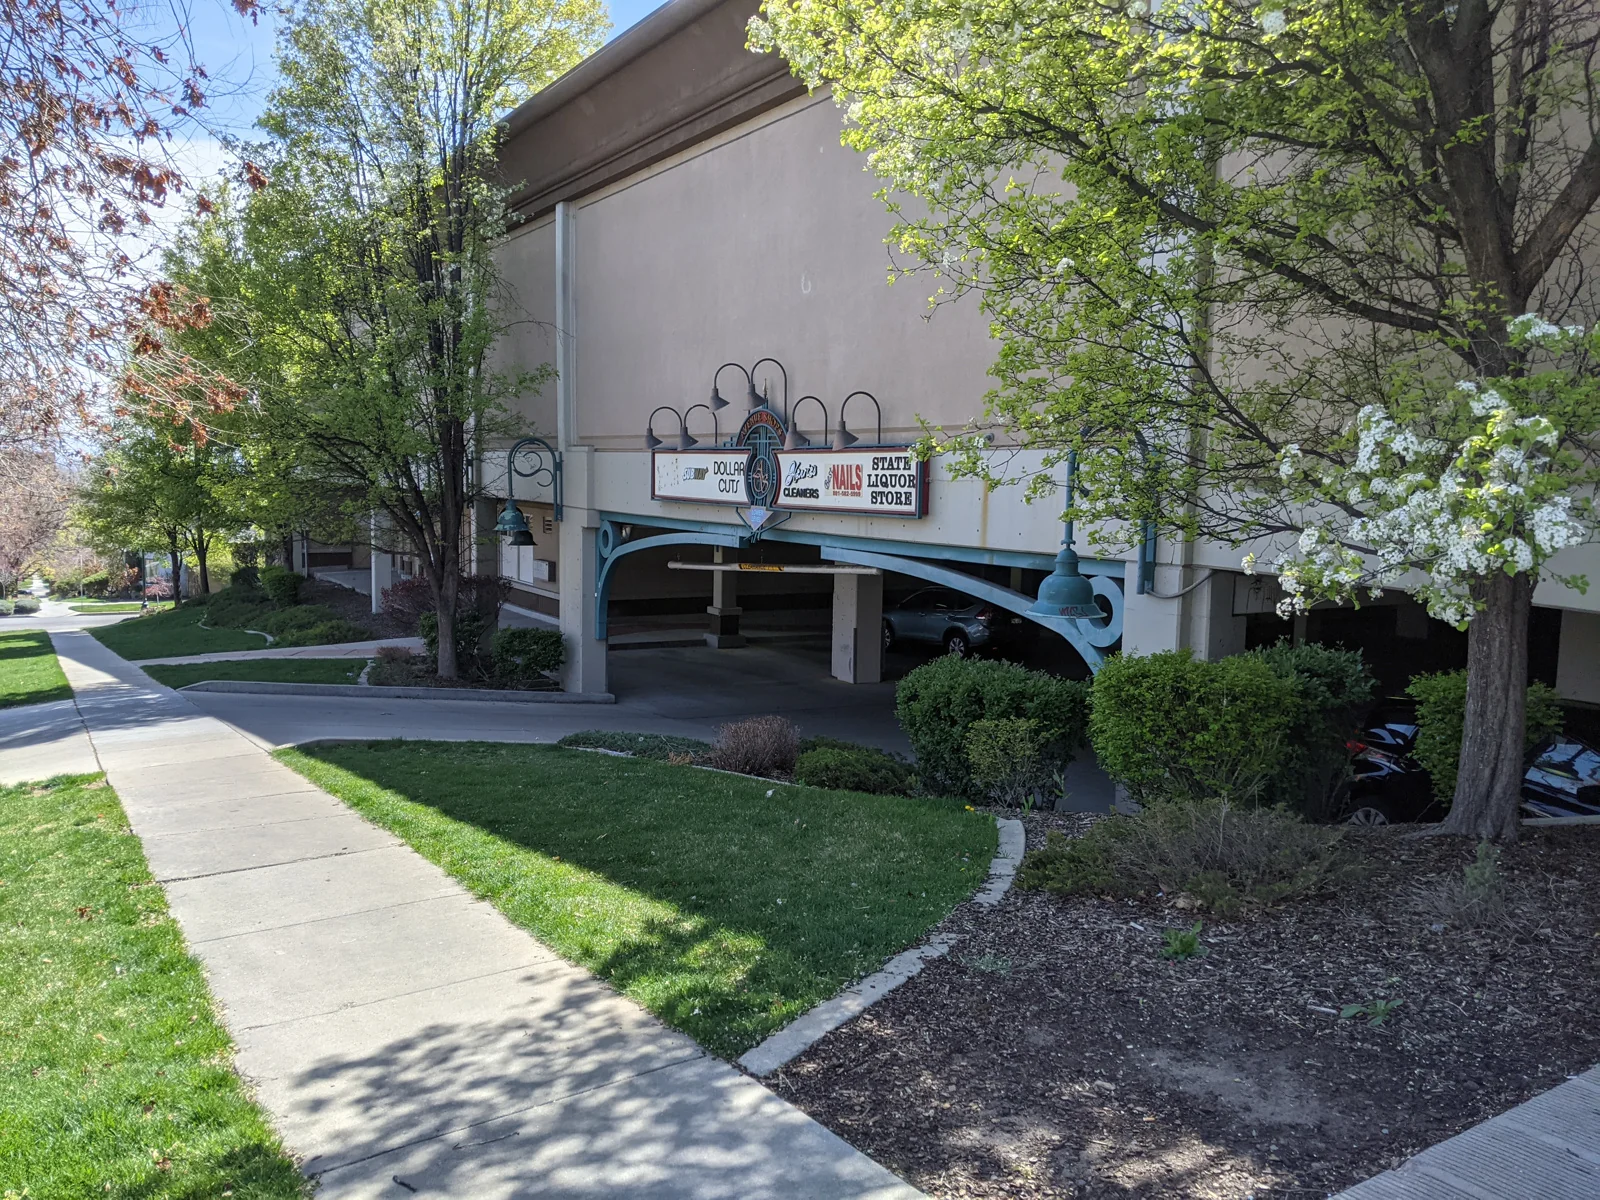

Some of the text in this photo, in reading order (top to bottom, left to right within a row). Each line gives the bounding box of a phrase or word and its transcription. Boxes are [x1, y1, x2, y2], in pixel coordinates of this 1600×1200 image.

[713, 461, 745, 476] DOLLAR
[872, 456, 912, 471] STATE
[682, 466, 709, 481] SUBWAY
[832, 464, 862, 491] NAILS
[867, 473, 917, 488] LIQUOR
[718, 478, 740, 494] CUTS
[783, 487, 820, 499] CLEANERS
[870, 490, 913, 506] STORE
